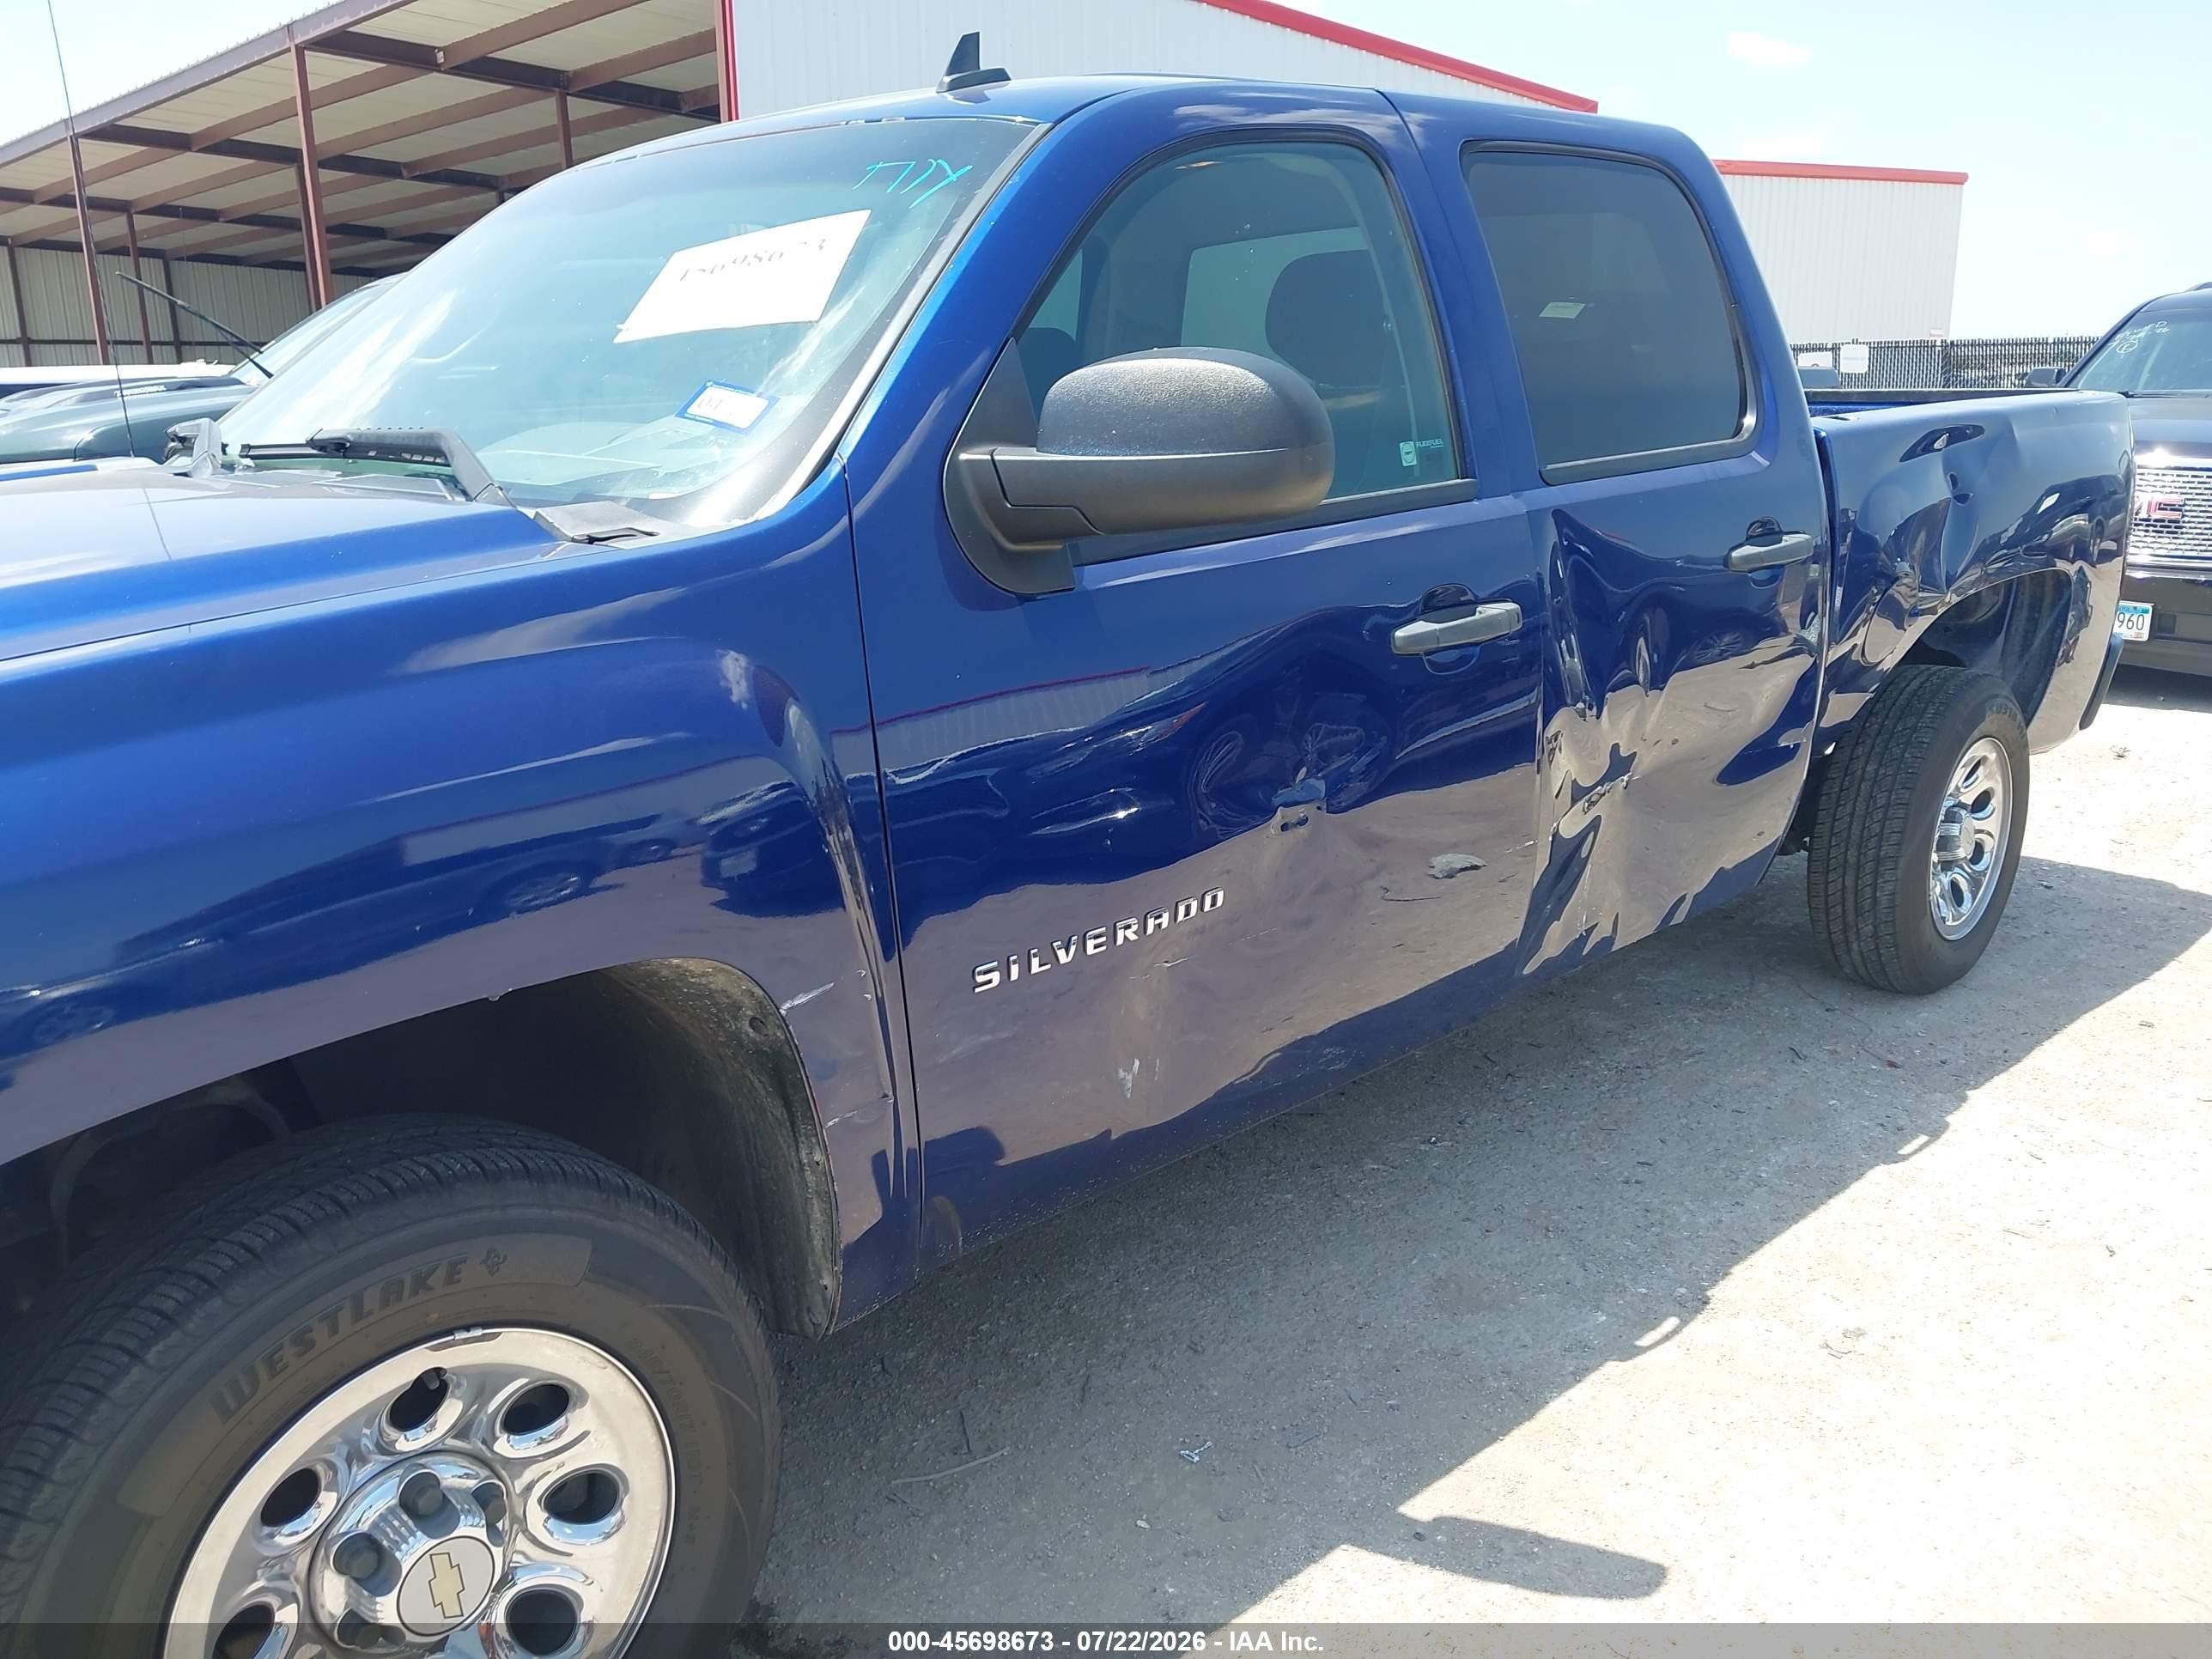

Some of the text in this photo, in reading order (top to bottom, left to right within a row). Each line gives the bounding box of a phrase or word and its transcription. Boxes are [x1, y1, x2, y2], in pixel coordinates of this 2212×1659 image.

[2117, 611, 2145, 631] 960
[972, 886, 1225, 994] SILVERADO
[208, 1256, 468, 1425] WESTLAKE
